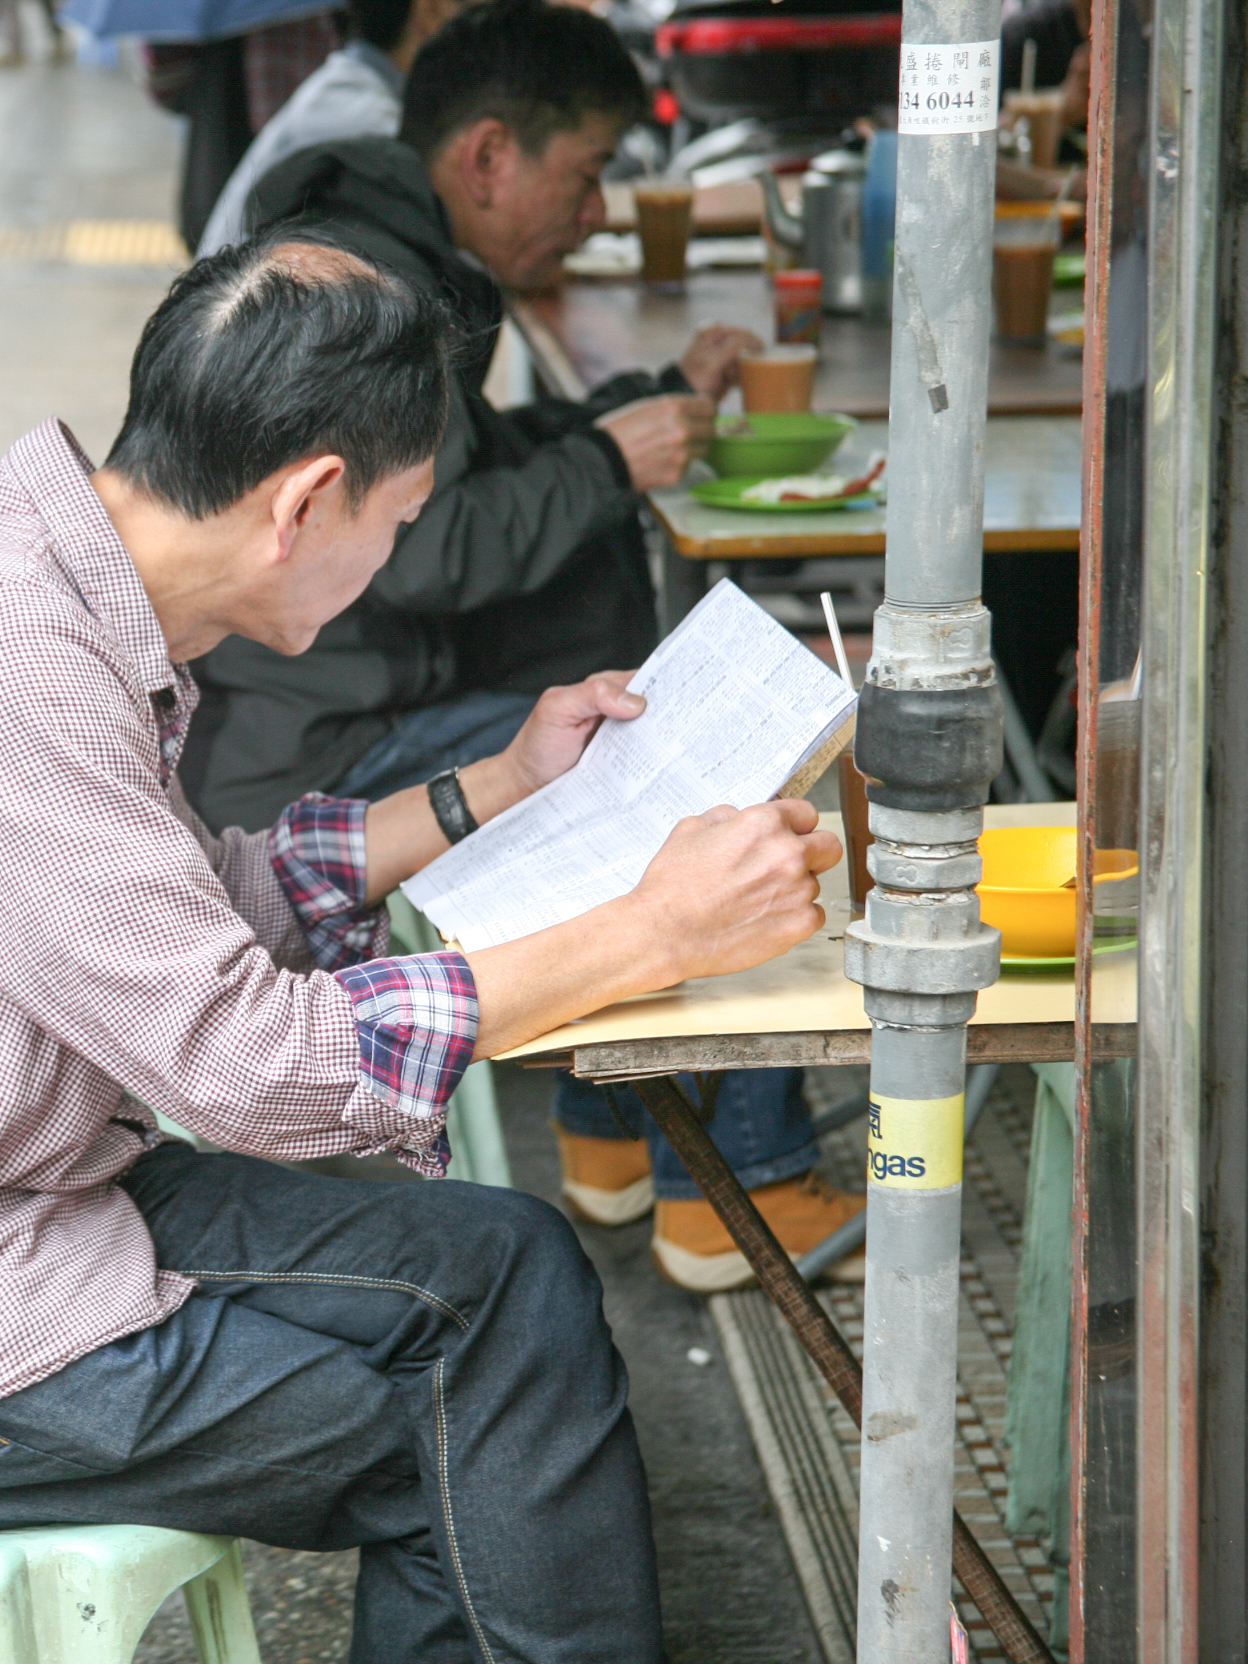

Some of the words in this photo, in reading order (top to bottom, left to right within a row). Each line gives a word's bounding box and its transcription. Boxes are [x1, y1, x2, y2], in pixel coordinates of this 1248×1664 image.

[899, 49, 991, 71] 盛捲閘廠
[926, 90, 974, 110] 6044
